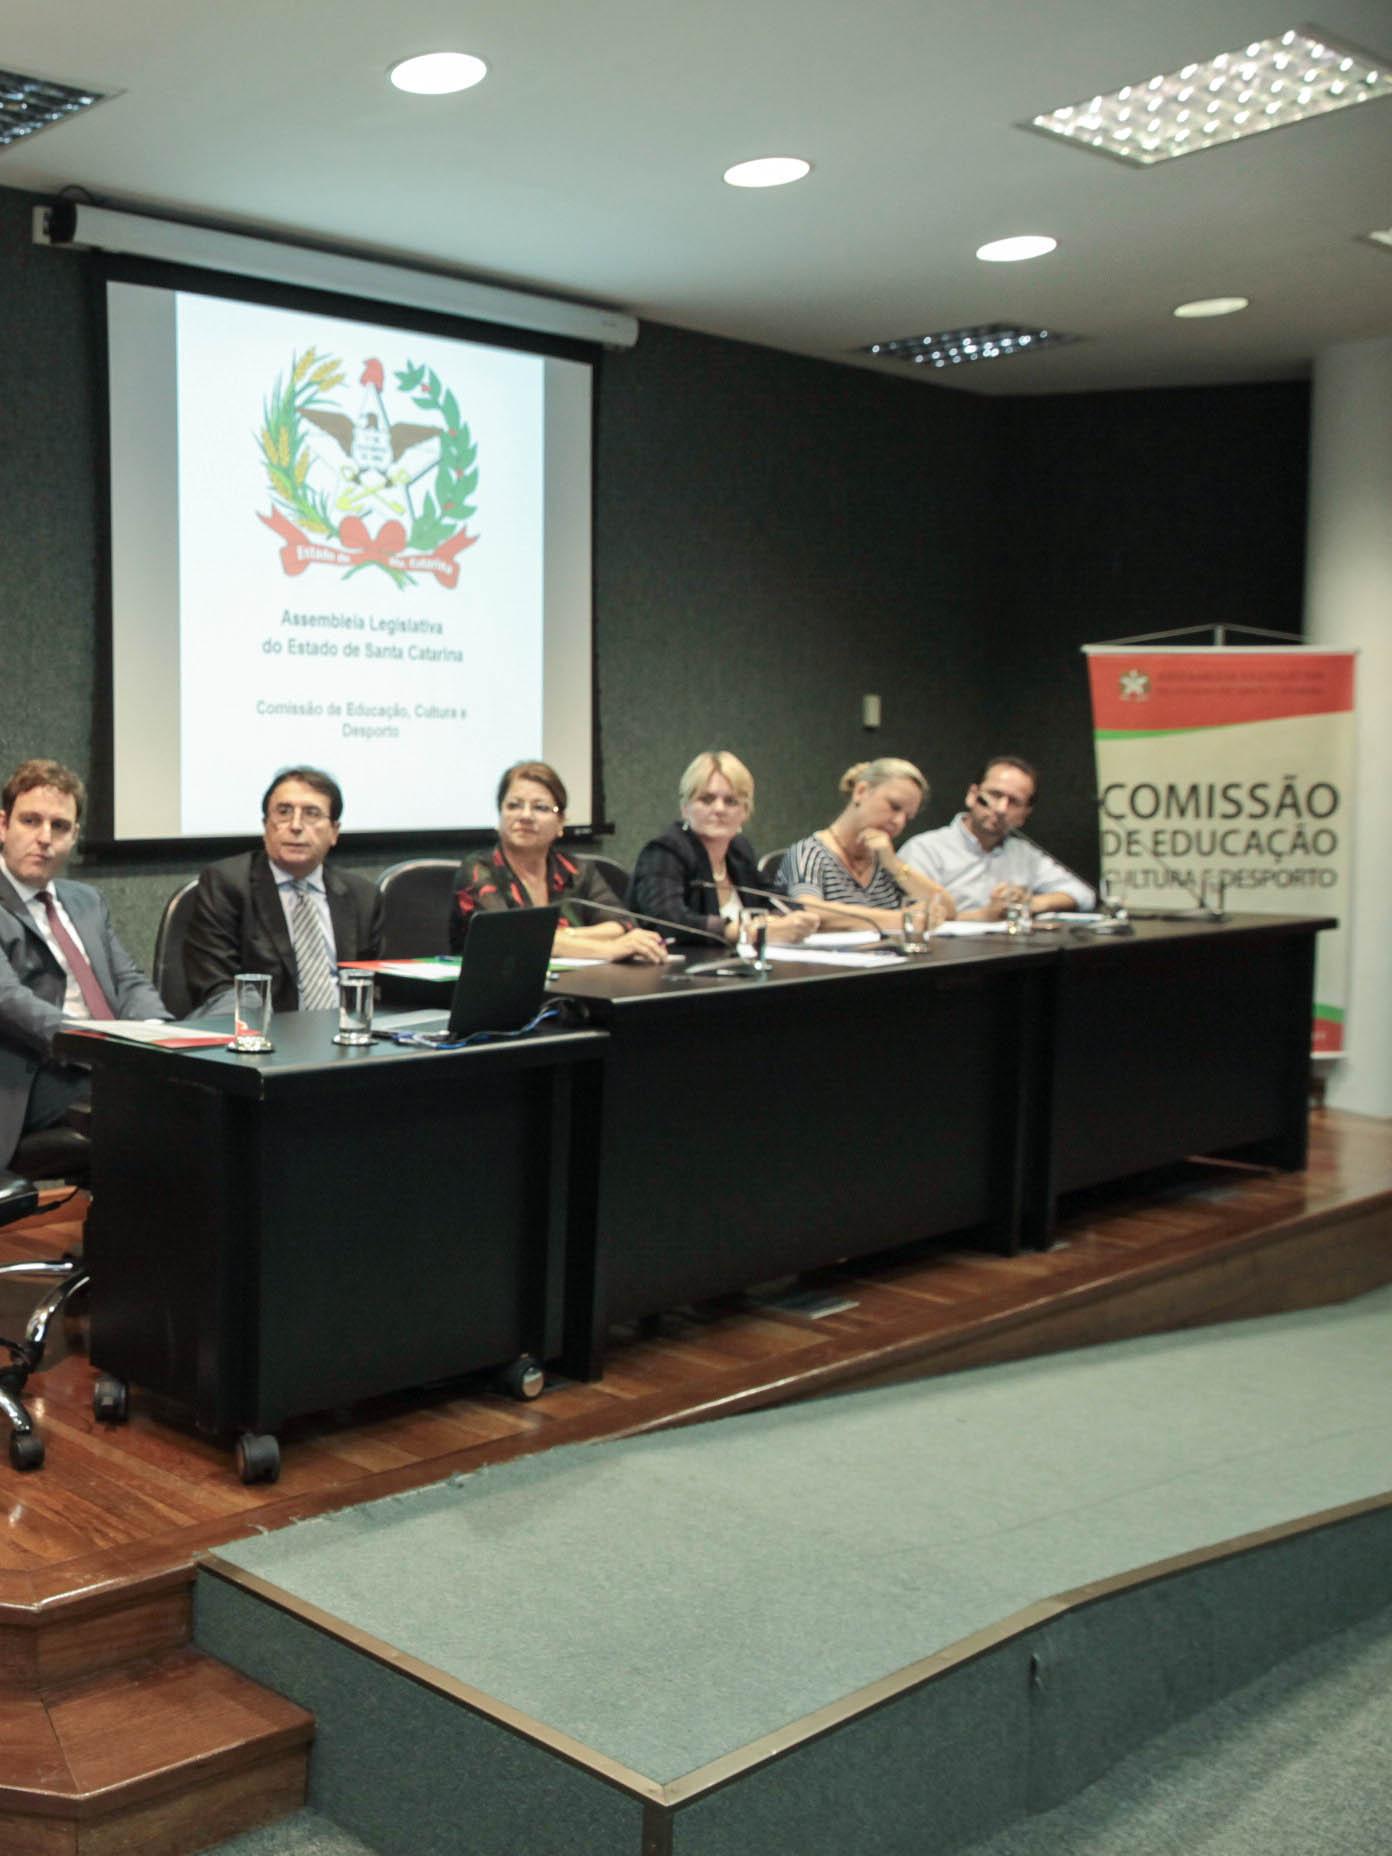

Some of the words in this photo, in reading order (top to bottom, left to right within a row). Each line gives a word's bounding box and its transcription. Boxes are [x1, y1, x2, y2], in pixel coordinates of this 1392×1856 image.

[281, 609, 365, 630] Assembleia
[370, 615, 444, 636] Legislativa
[262, 637, 282, 654] do
[288, 639, 338, 657] Estado
[342, 642, 360, 658] de
[365, 643, 403, 660] Santa
[408, 645, 464, 663] Catarina
[256, 700, 323, 716] Comissão
[327, 702, 342, 717] de
[414, 704, 457, 719] Cultura
[460, 708, 467, 719] e
[342, 723, 399, 741] Desporto
[1103, 774, 1340, 820] COMISSÃO
[1101, 828, 1142, 857] DE
[1152, 822, 1338, 863] EDUCAÇÃO
[1220, 868, 1338, 888] DESPORTO
